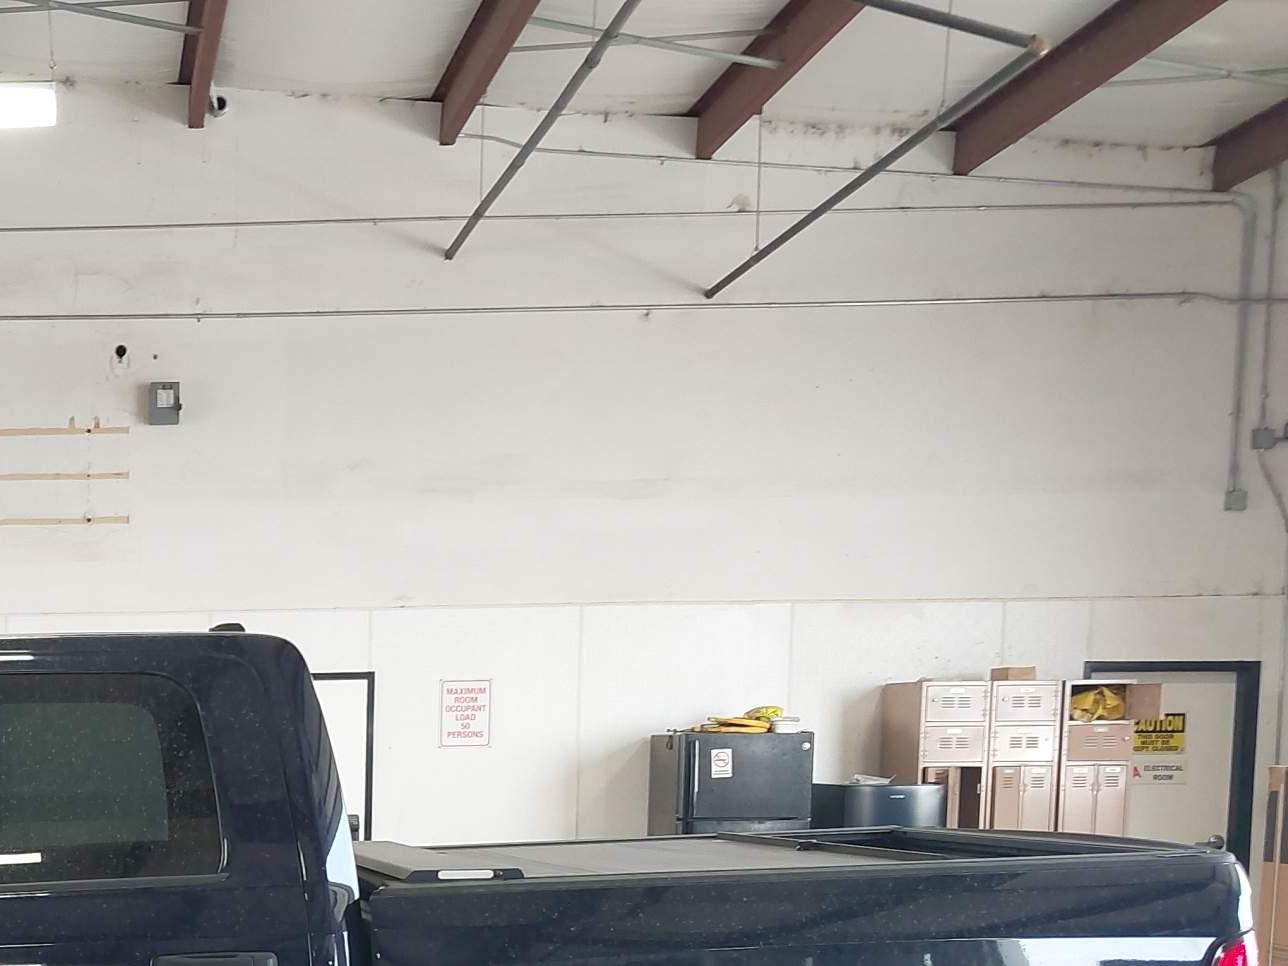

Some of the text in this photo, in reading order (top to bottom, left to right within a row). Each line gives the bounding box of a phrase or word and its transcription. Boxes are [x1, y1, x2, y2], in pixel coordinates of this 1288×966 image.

[446, 687, 486, 695] MAXIMUM
[454, 696, 478, 704] ROOM
[455, 713, 476, 721] LOAD
[460, 722, 471, 730] 50
[447, 730, 484, 738] PERSONS
